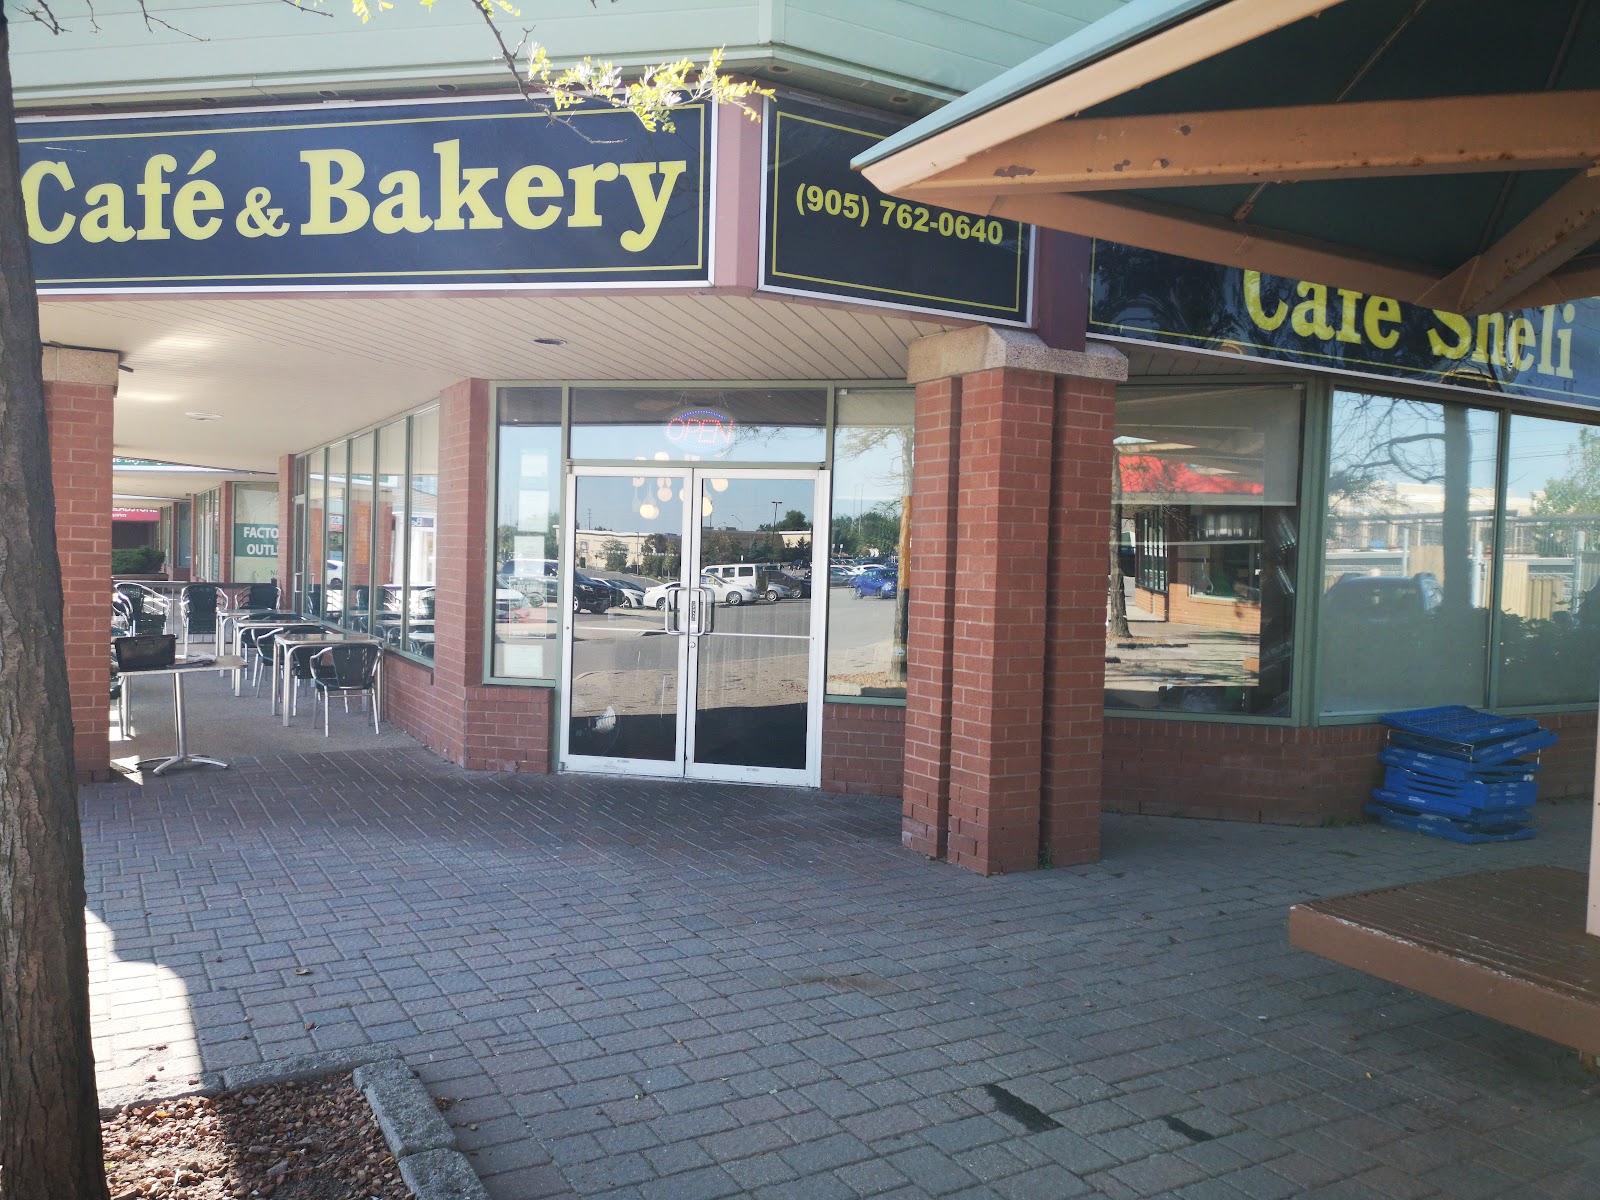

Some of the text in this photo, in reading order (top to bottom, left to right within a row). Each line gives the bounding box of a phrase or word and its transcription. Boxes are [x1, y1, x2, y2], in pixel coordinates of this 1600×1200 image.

[21, 139, 687, 252] Café & Bakery
[796, 183, 1003, 245] (905) 762-0640
[667, 418, 734, 443] OPEN
[243, 527, 279, 539] FACTO
[246, 543, 279, 556] OUTL
